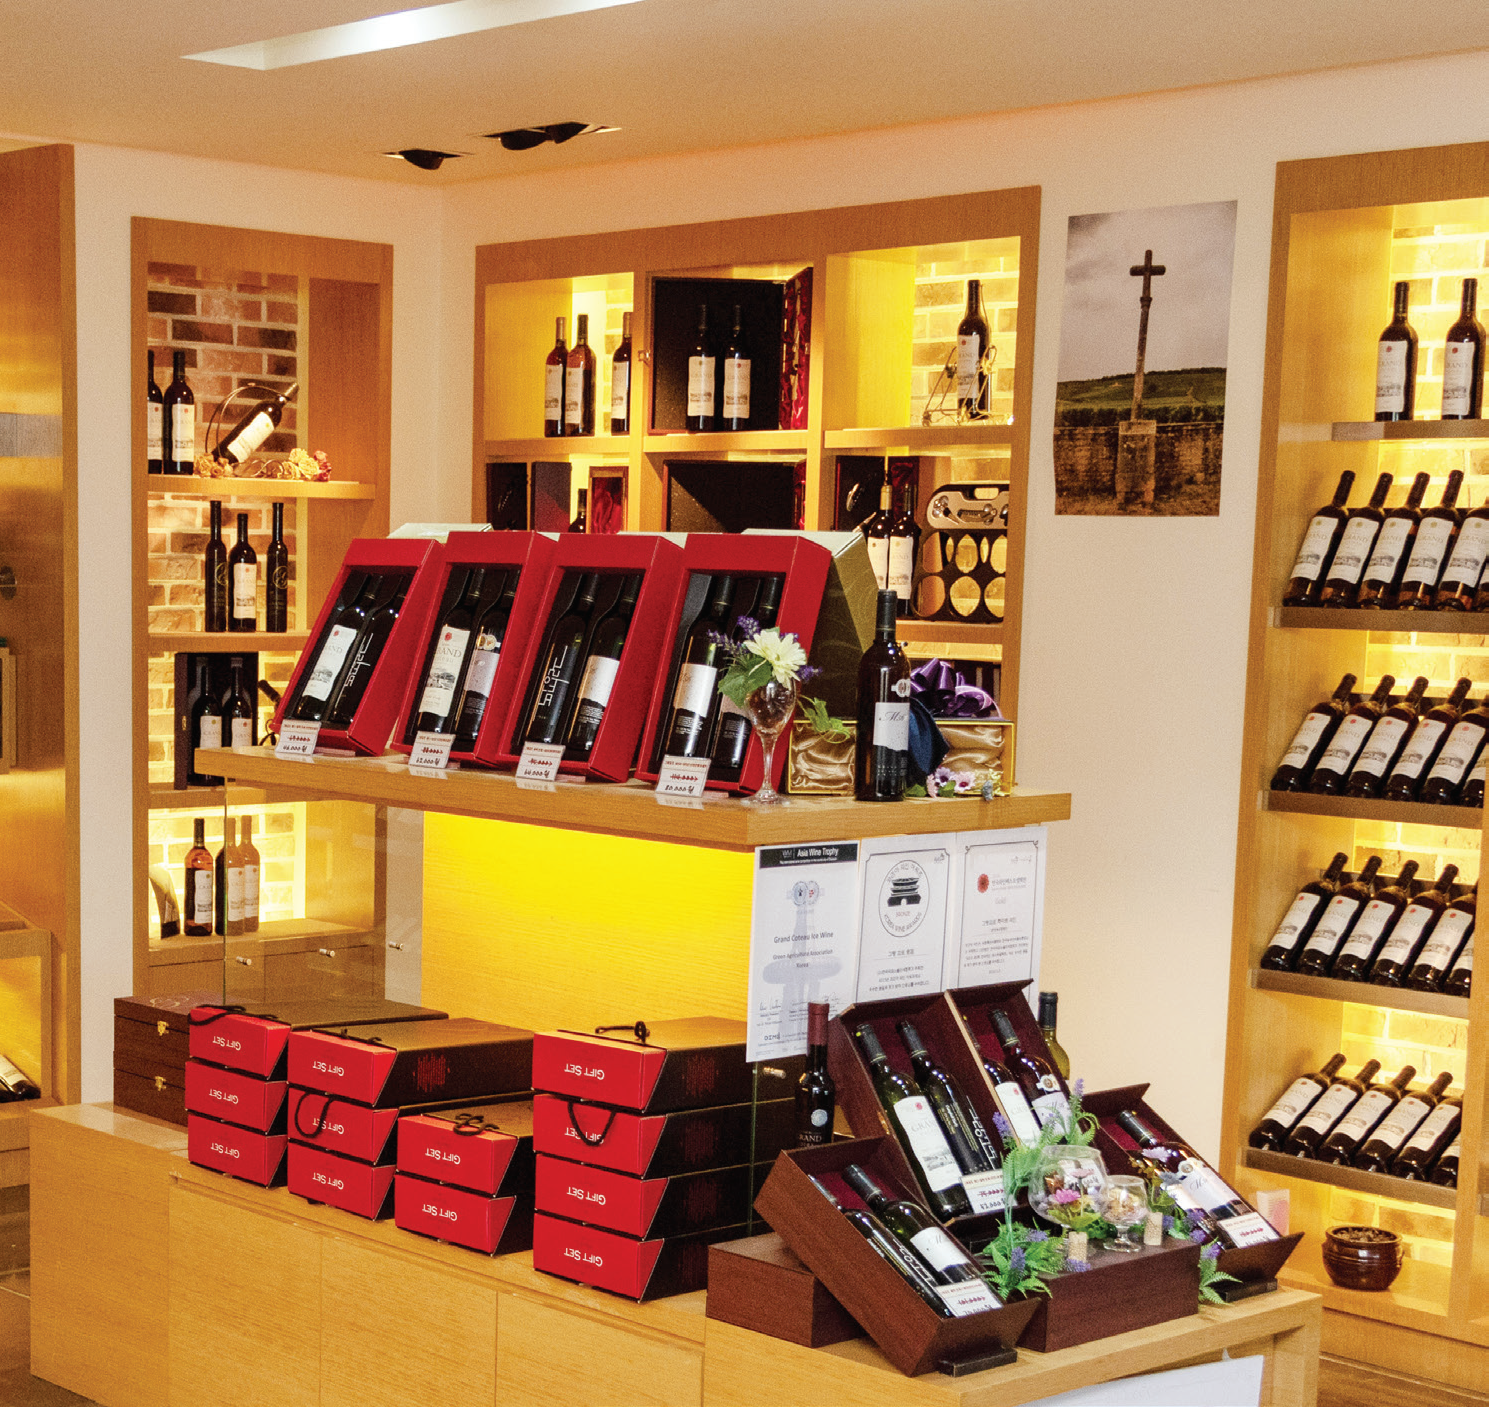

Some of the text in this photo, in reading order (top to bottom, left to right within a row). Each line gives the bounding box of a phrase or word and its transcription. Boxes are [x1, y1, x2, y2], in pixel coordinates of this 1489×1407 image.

[773, 936, 790, 944] Grand
[791, 934, 810, 942] Coteau
[820, 931, 834, 939] Wine
[212, 1035, 242, 1051] GIFT SET
[312, 1060, 345, 1077] GIFT SET
[564, 1063, 605, 1080] GIFT SET
[209, 1088, 240, 1105] GIFT SET
[327, 1121, 345, 1134] GIFT
[210, 1142, 240, 1159] GIFT SET
[425, 1147, 461, 1165] GIFT SET
[312, 1171, 345, 1190] GIFT SET
[567, 1186, 606, 1205] GIFT SET
[422, 1203, 458, 1221] GIFT SET
[564, 1247, 603, 1267] GIFT SET
